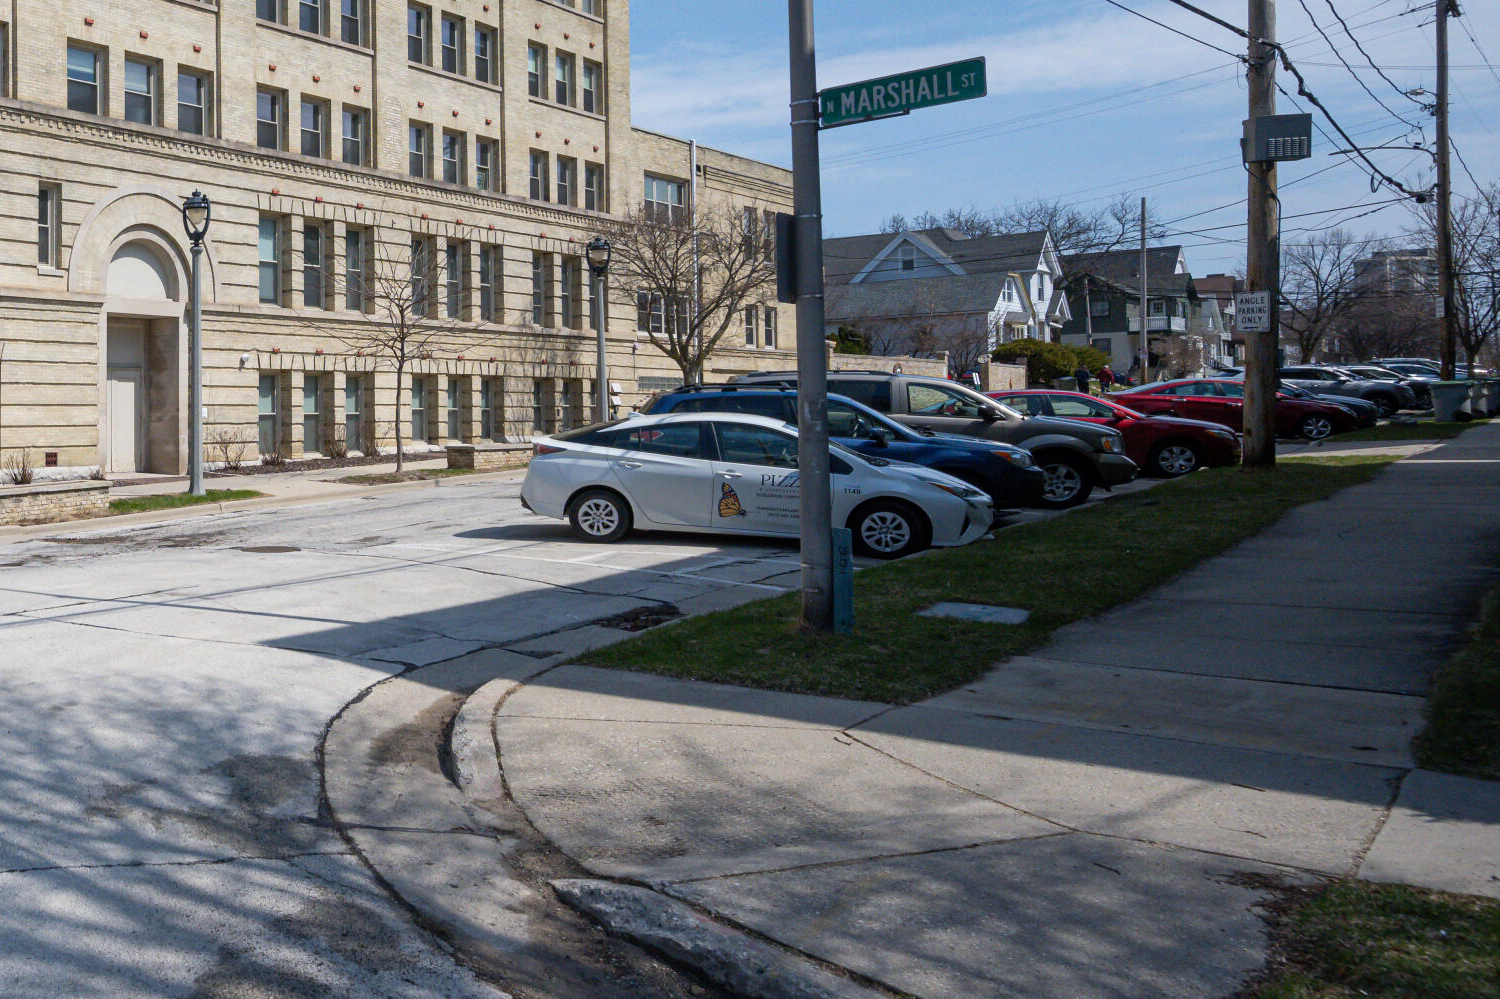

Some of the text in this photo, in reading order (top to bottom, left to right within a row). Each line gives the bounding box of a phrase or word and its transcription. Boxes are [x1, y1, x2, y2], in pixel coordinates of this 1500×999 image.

[827, 71, 977, 117] N MARSHALL ST
[1240, 296, 1265, 305] ANGLE
[1238, 306, 1267, 315] PARKING
[1241, 315, 1262, 324] ONLY
[843, 487, 861, 496] 1149
